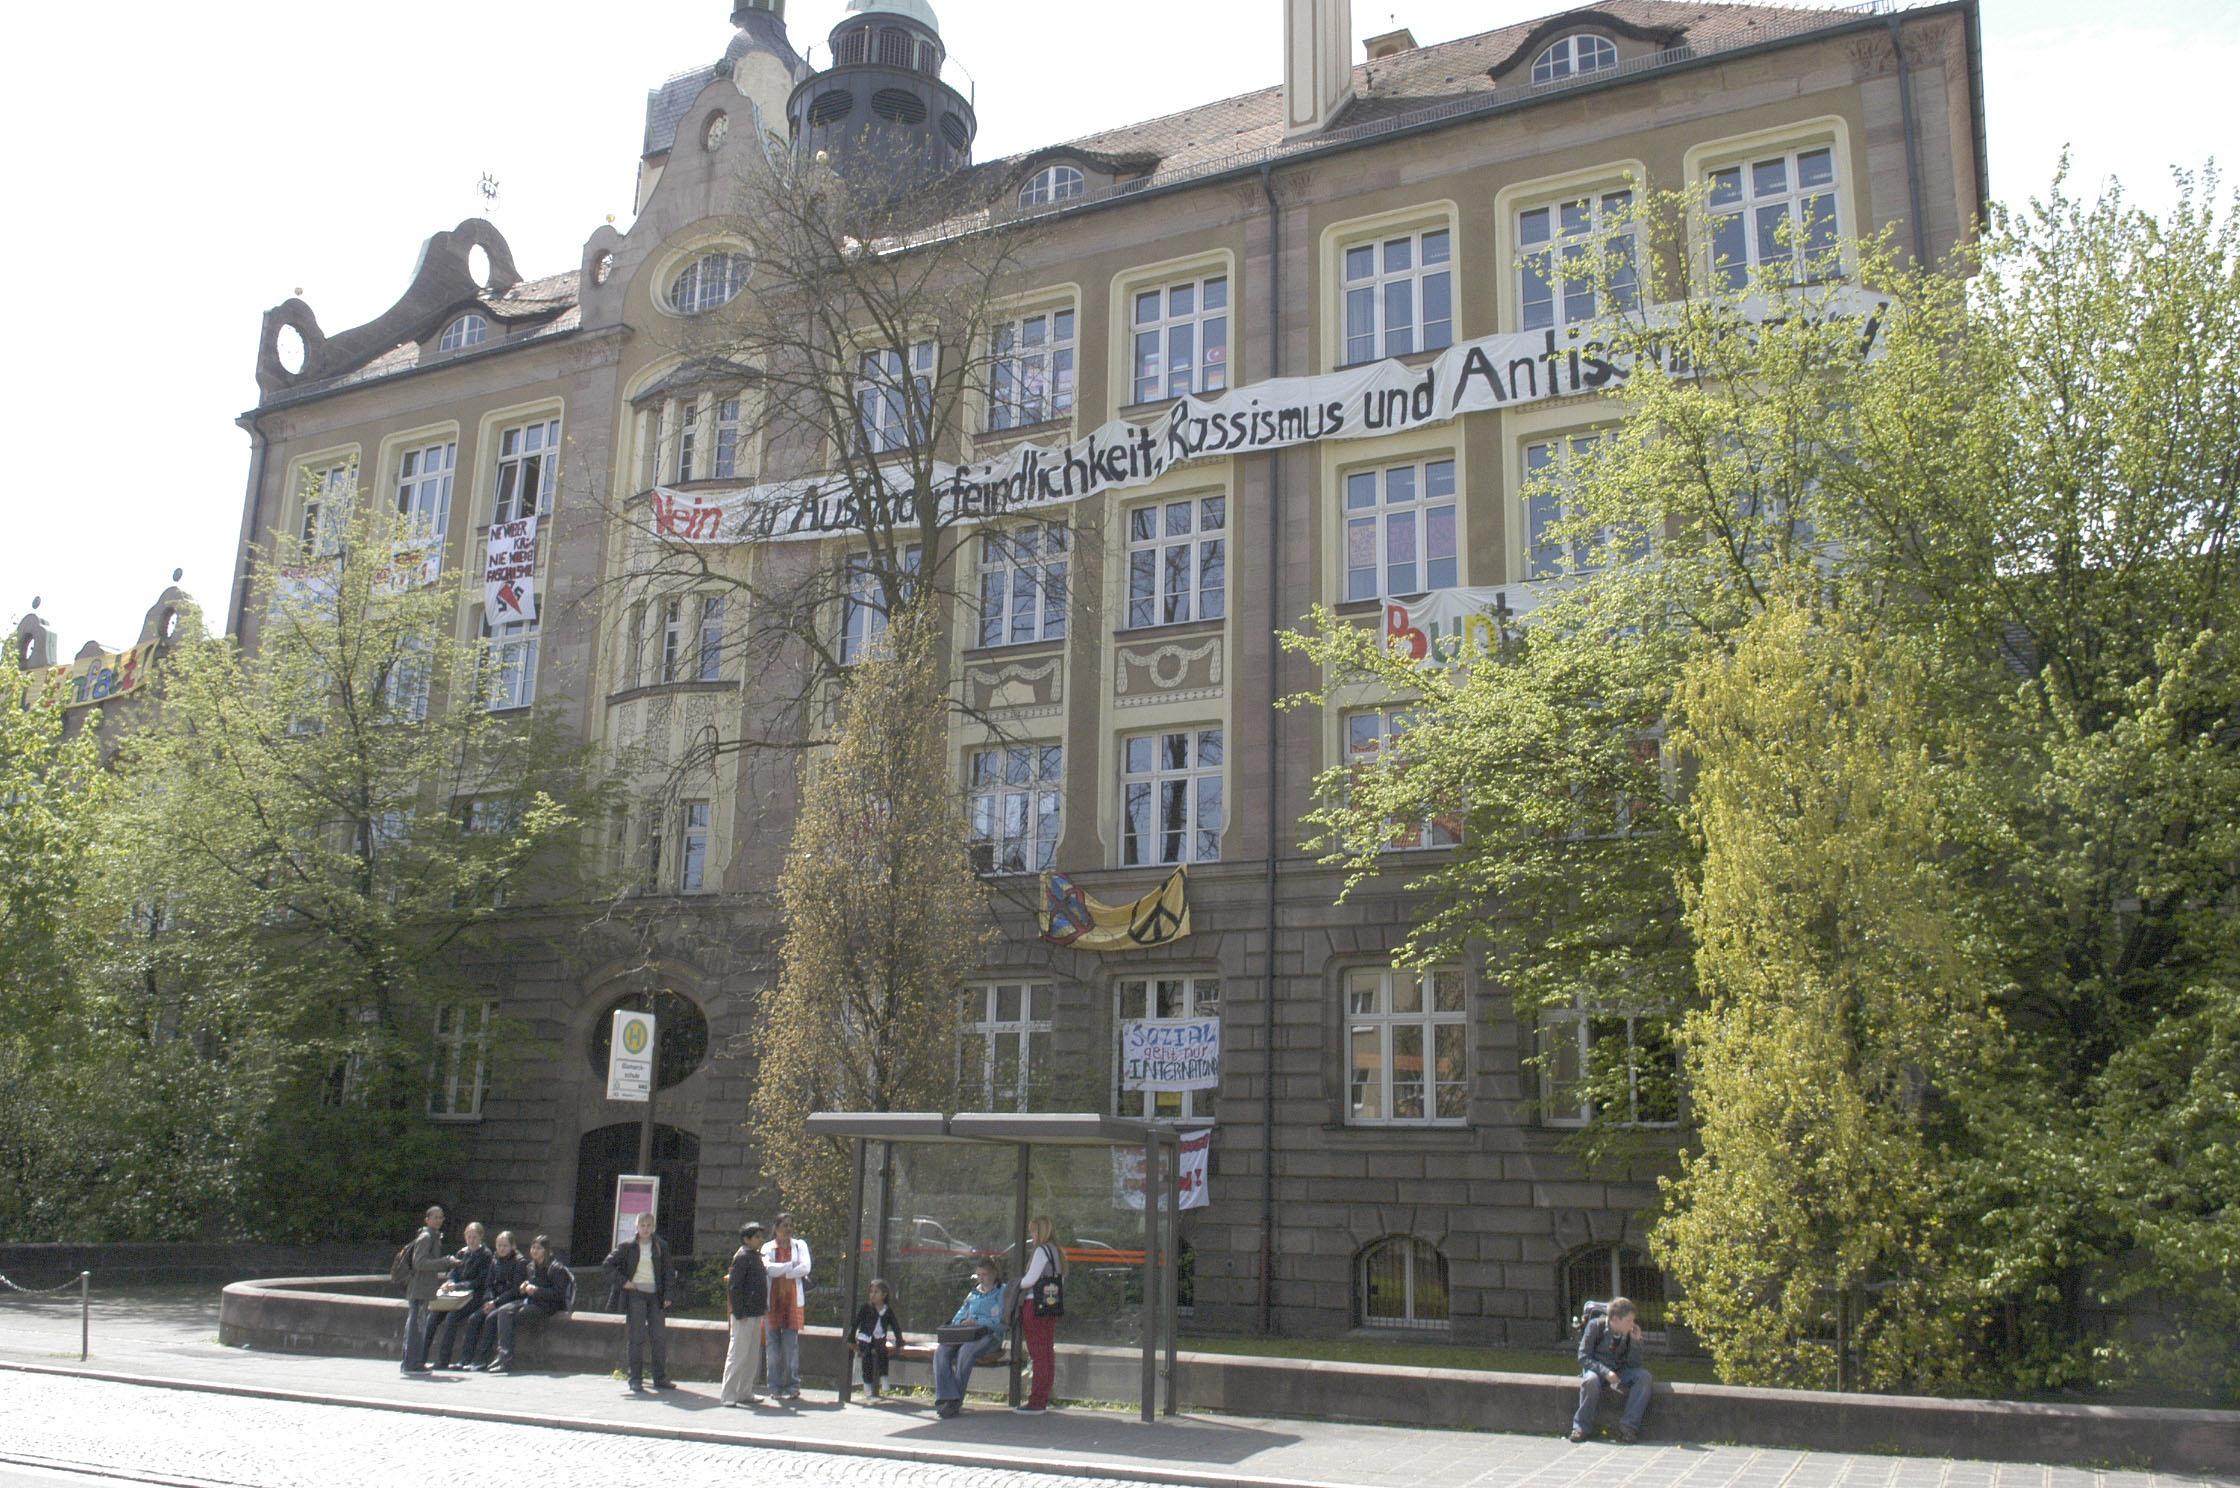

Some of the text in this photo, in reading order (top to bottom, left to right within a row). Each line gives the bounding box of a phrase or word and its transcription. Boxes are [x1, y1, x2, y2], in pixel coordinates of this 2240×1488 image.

[651, 490, 723, 540] Nein
[788, 427, 1163, 532] Auslndrfeindlichkeit,
[1168, 400, 1344, 460] Rassismus
[1364, 366, 1436, 429] und
[489, 551, 507, 568] NIE
[1387, 591, 1513, 663] Bunt
[1131, 1024, 1217, 1047] SOZIAL
[1144, 1045, 1209, 1061] geht nur
